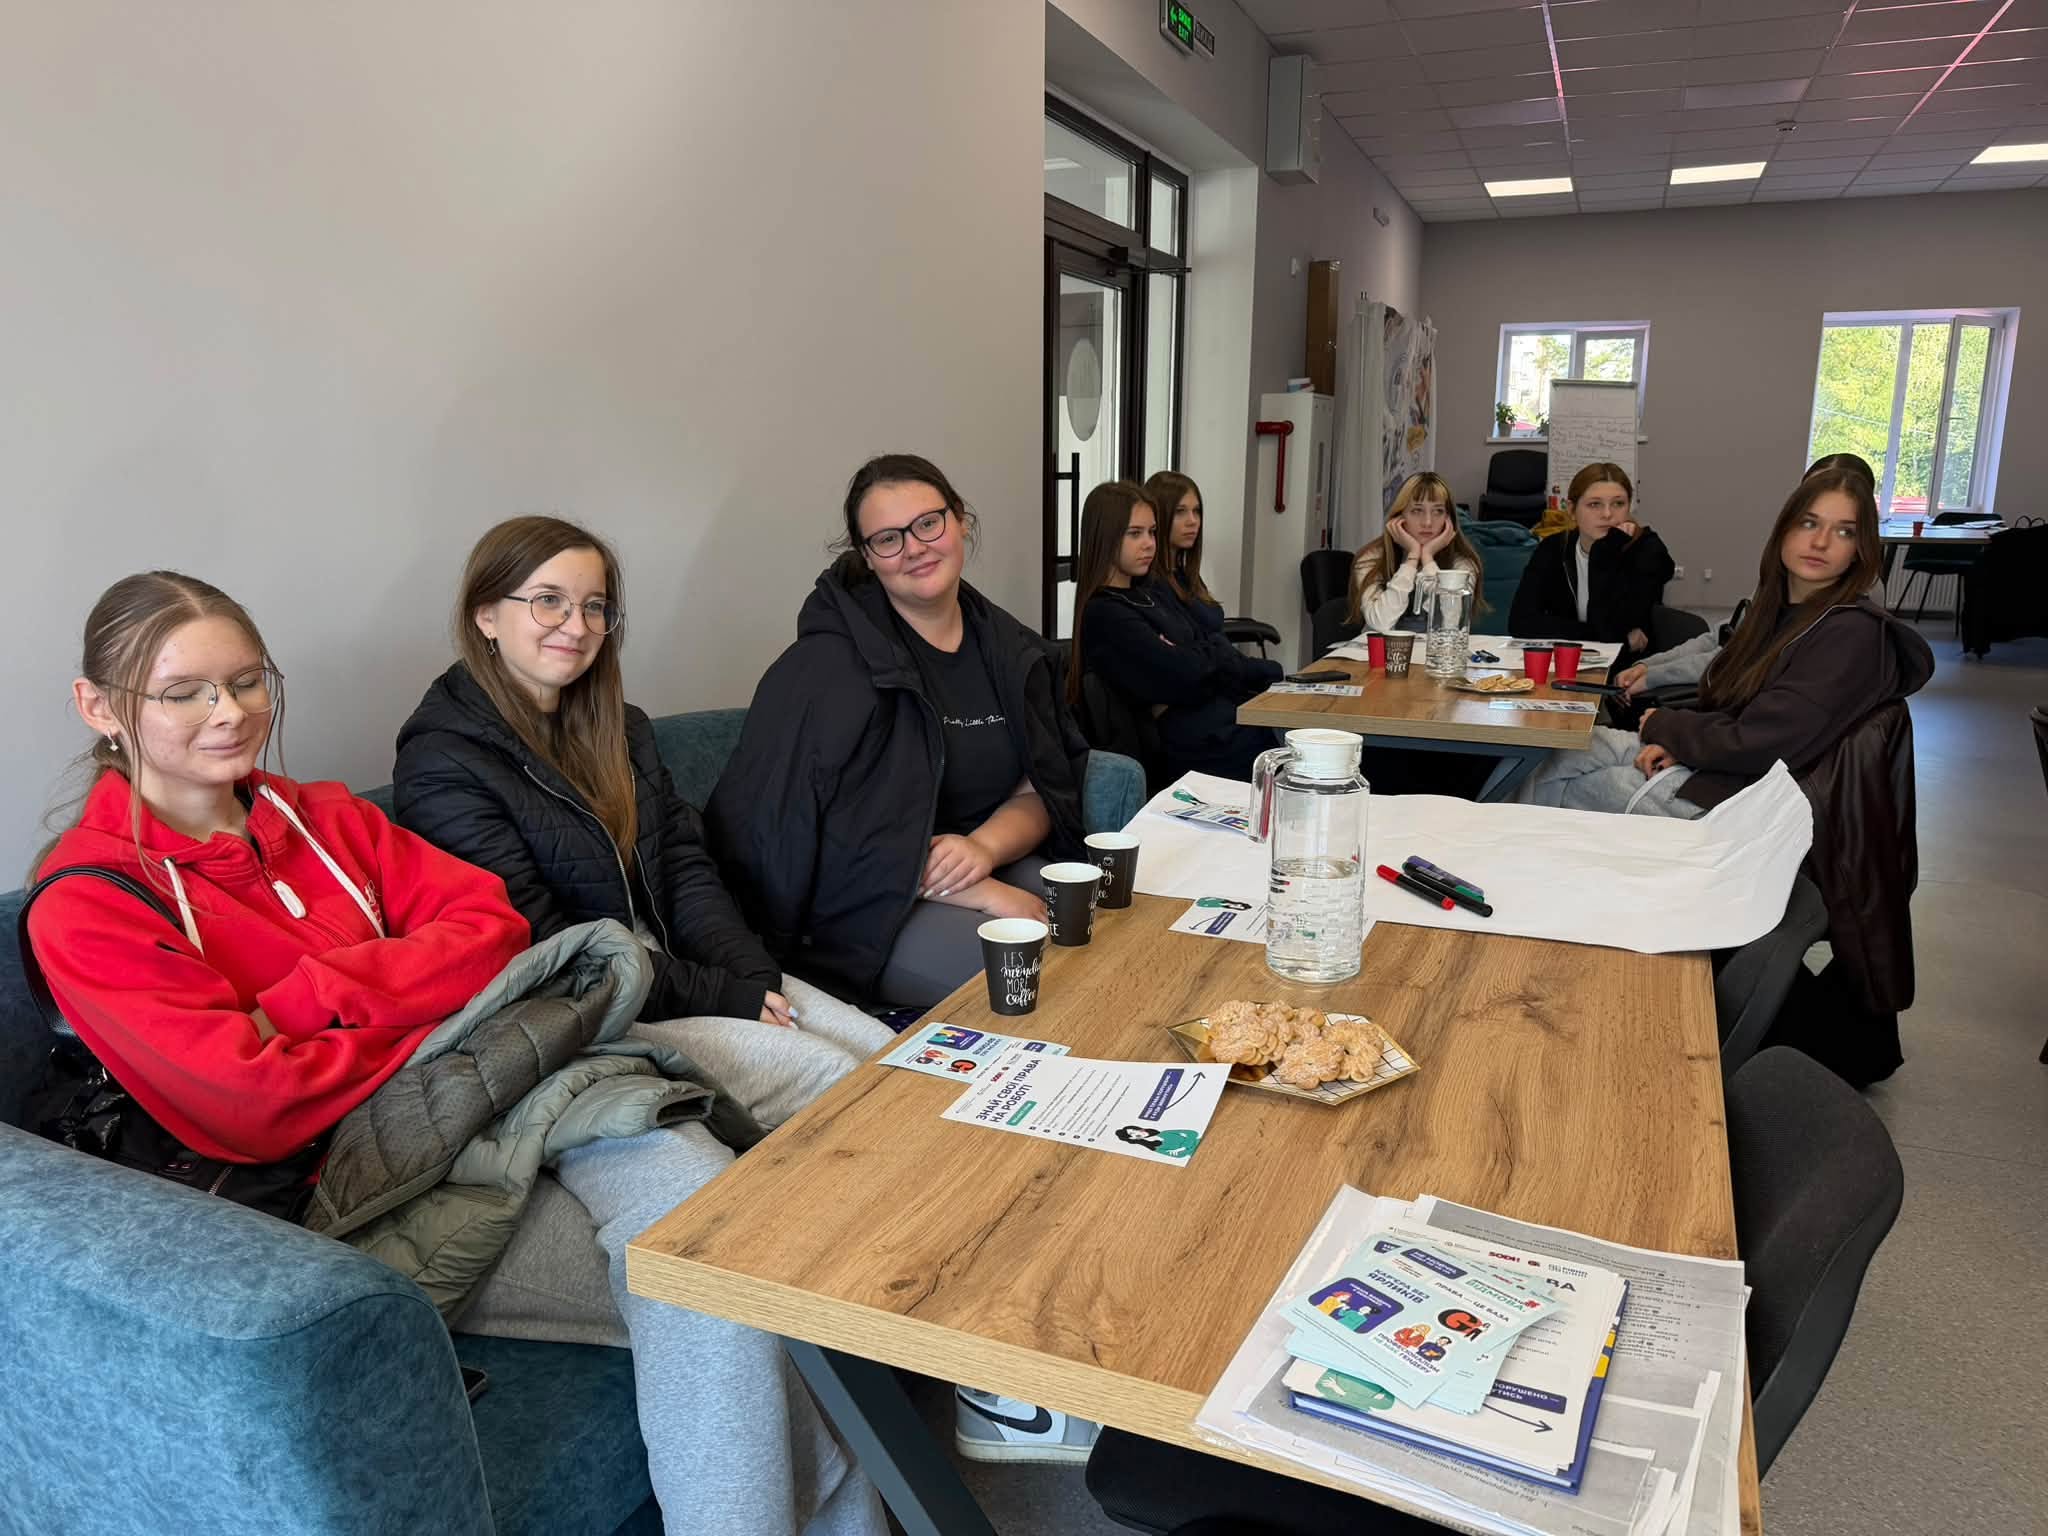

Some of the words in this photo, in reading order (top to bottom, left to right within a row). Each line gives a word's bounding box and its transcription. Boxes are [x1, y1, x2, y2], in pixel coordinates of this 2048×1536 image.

[965, 718, 984, 727] Little
[976, 1097, 999, 1121] ЗНАЙ
[997, 1080, 1015, 1102] СВОЇ
[1013, 1059, 1041, 1082] ПРАВА
[989, 1108, 1006, 1123] НА
[1004, 1084, 1032, 1111] РОБОТІ
[1368, 1272, 1424, 1303] ЯРЛИКІВ
[1434, 1282, 1463, 1299] ПРАВА
[1473, 1300, 1486, 1311] ЦЕ
[1487, 1309, 1510, 1322] БАЗА
